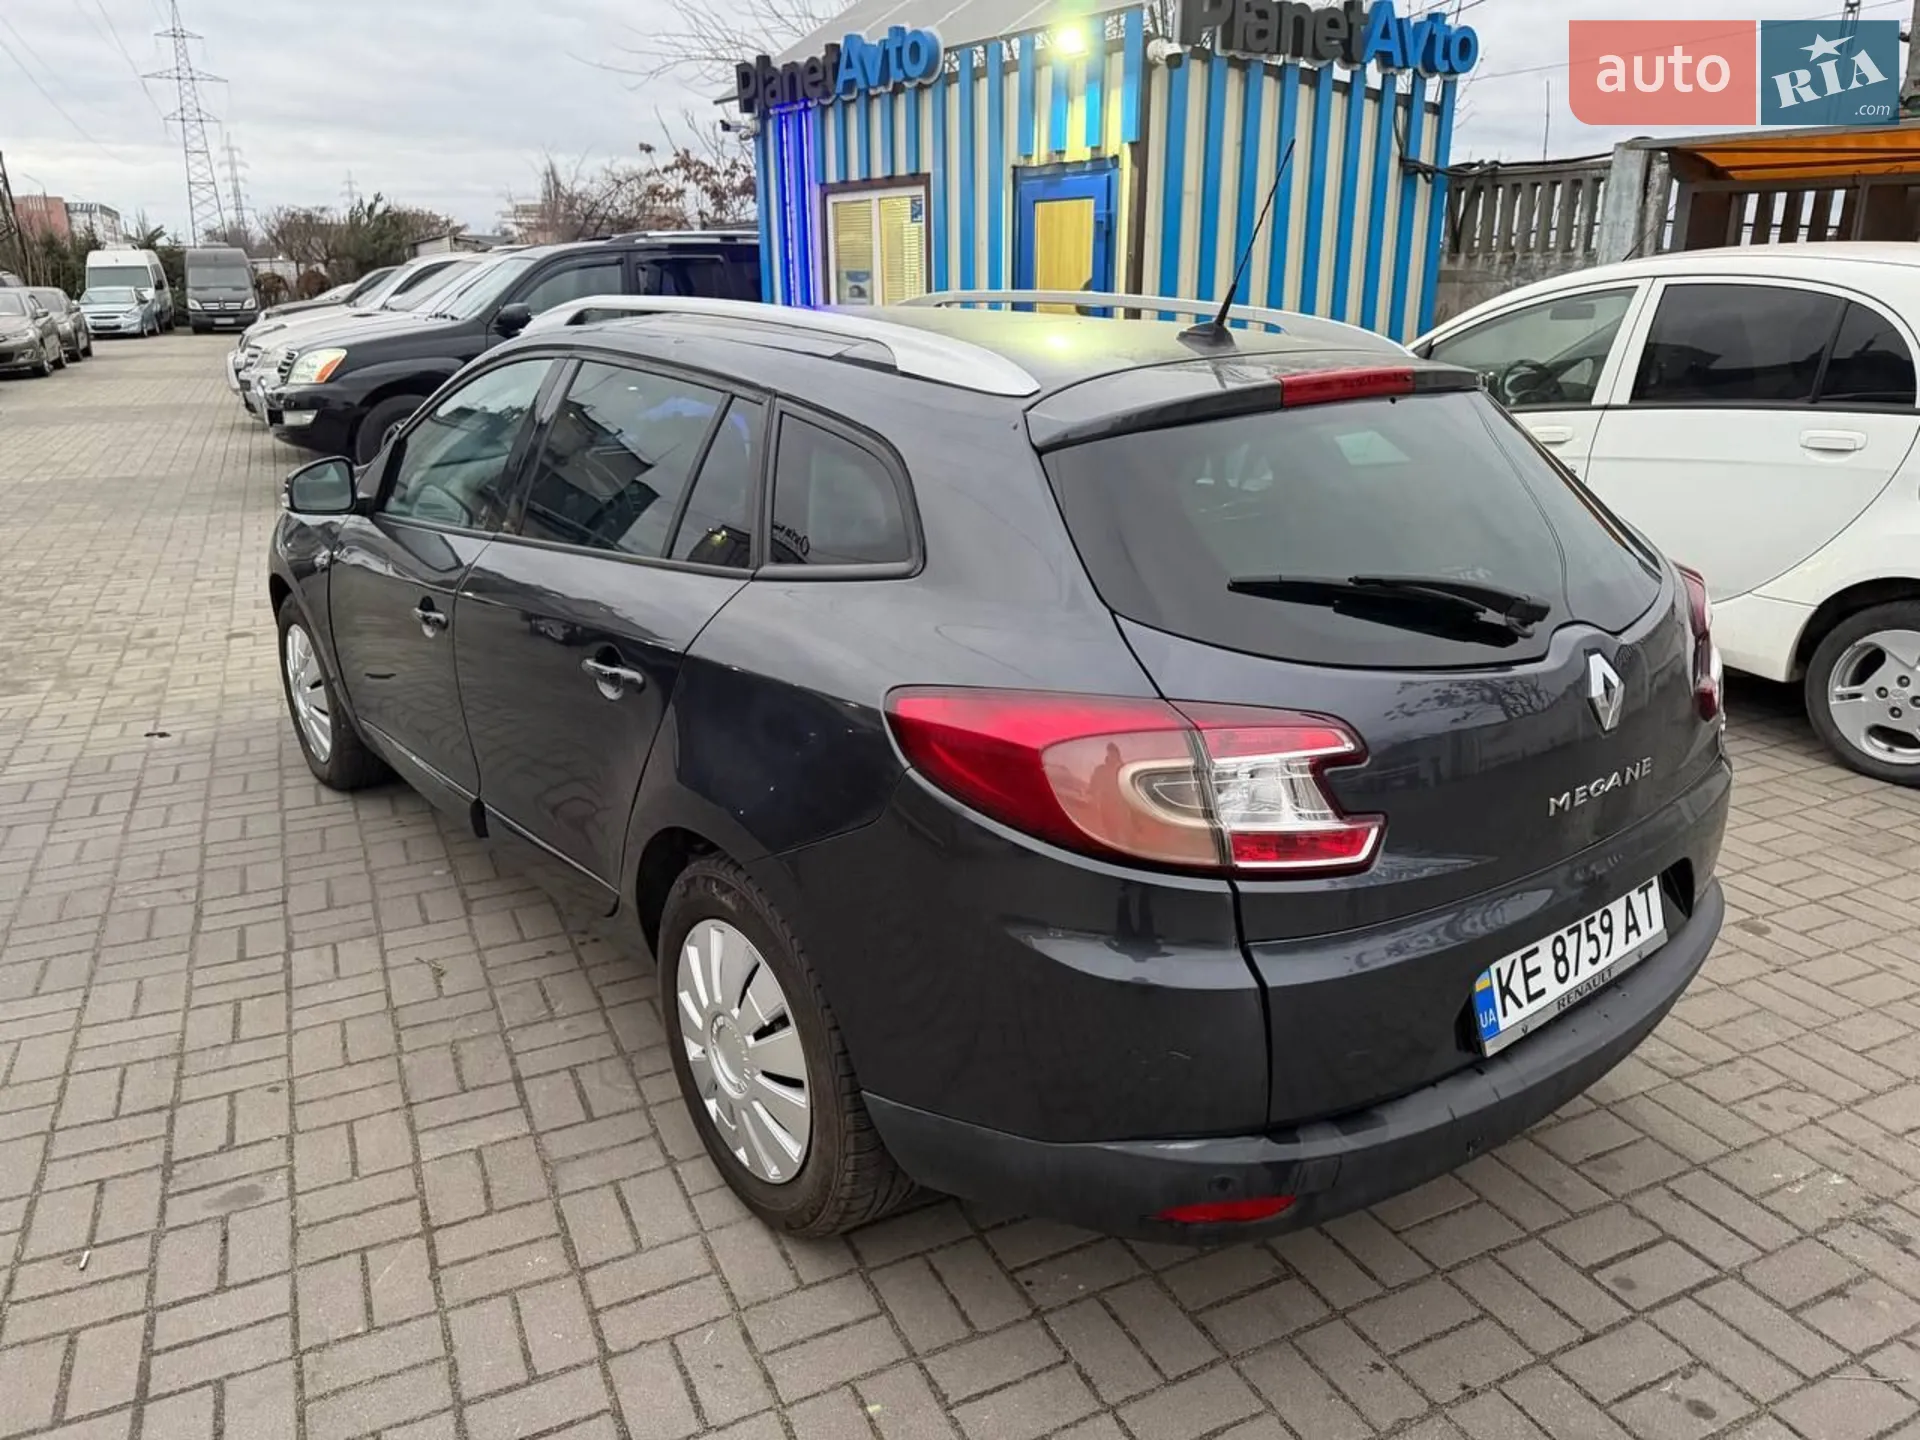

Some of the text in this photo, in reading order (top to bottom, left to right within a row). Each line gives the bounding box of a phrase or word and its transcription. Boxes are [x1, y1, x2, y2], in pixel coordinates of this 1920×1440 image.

[1549, 757, 1653, 817] MEGANE
[1496, 881, 1655, 1018] KE 8759 AT
[1556, 968, 1614, 1012] RENAULT
[1480, 1008, 1498, 1028] UA
